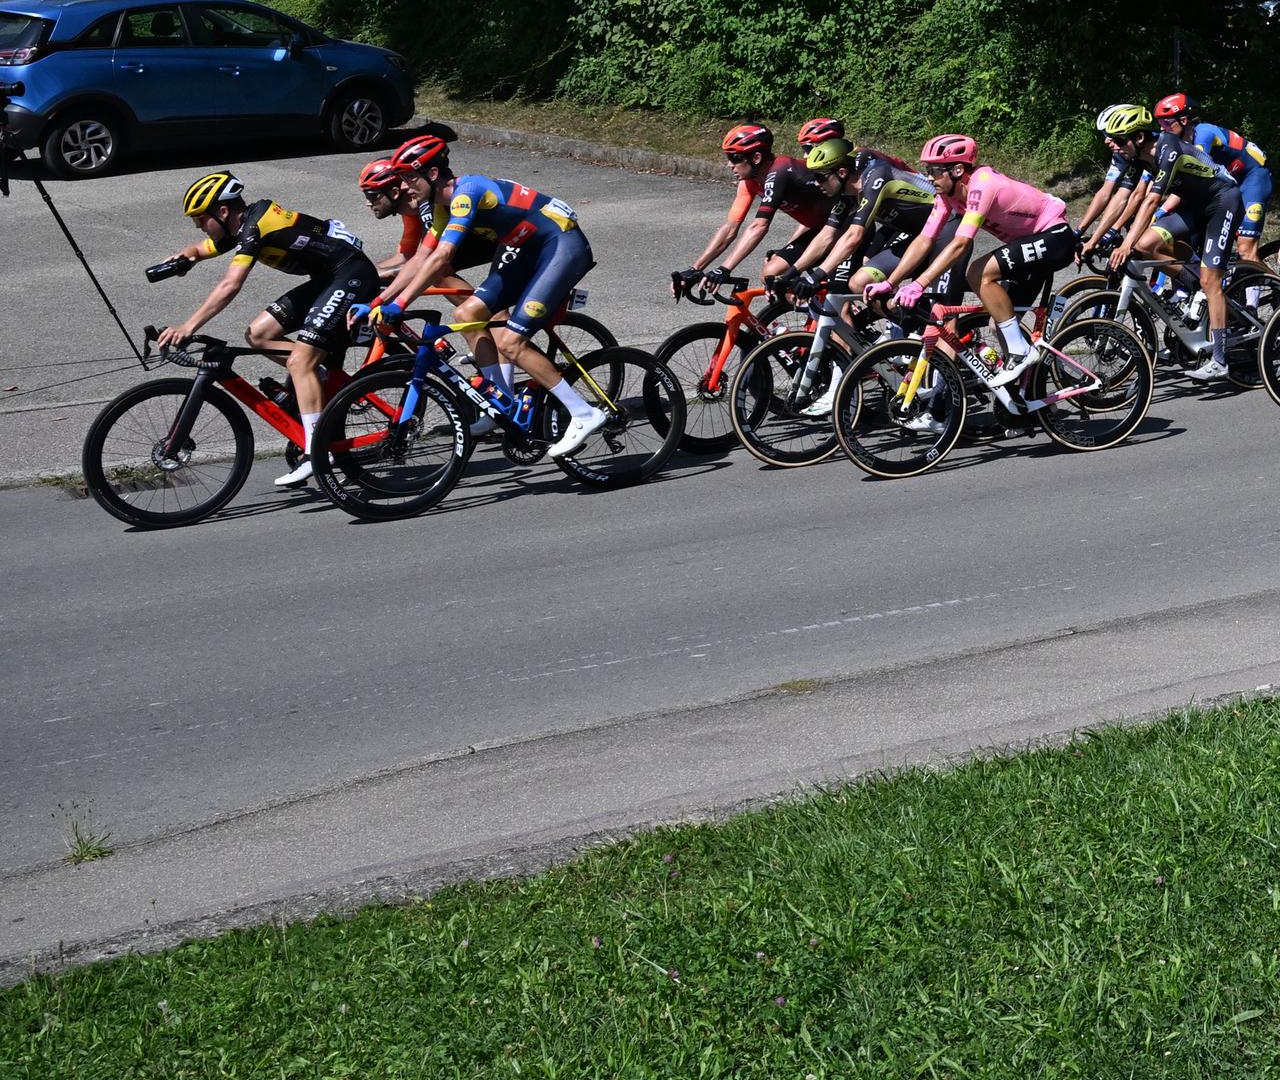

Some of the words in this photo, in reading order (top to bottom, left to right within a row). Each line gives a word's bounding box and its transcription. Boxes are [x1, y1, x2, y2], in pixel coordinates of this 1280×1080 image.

[762, 171, 776, 203] INEOS
[1020, 239, 1047, 264] EF
[834, 252, 852, 281] INE
[317, 289, 346, 319] LOTTO
[1054, 302, 1065, 313] 81
[438, 360, 501, 418] TREK
[655, 367, 676, 392] AEOLUS
[324, 473, 347, 501] AEOLUS
